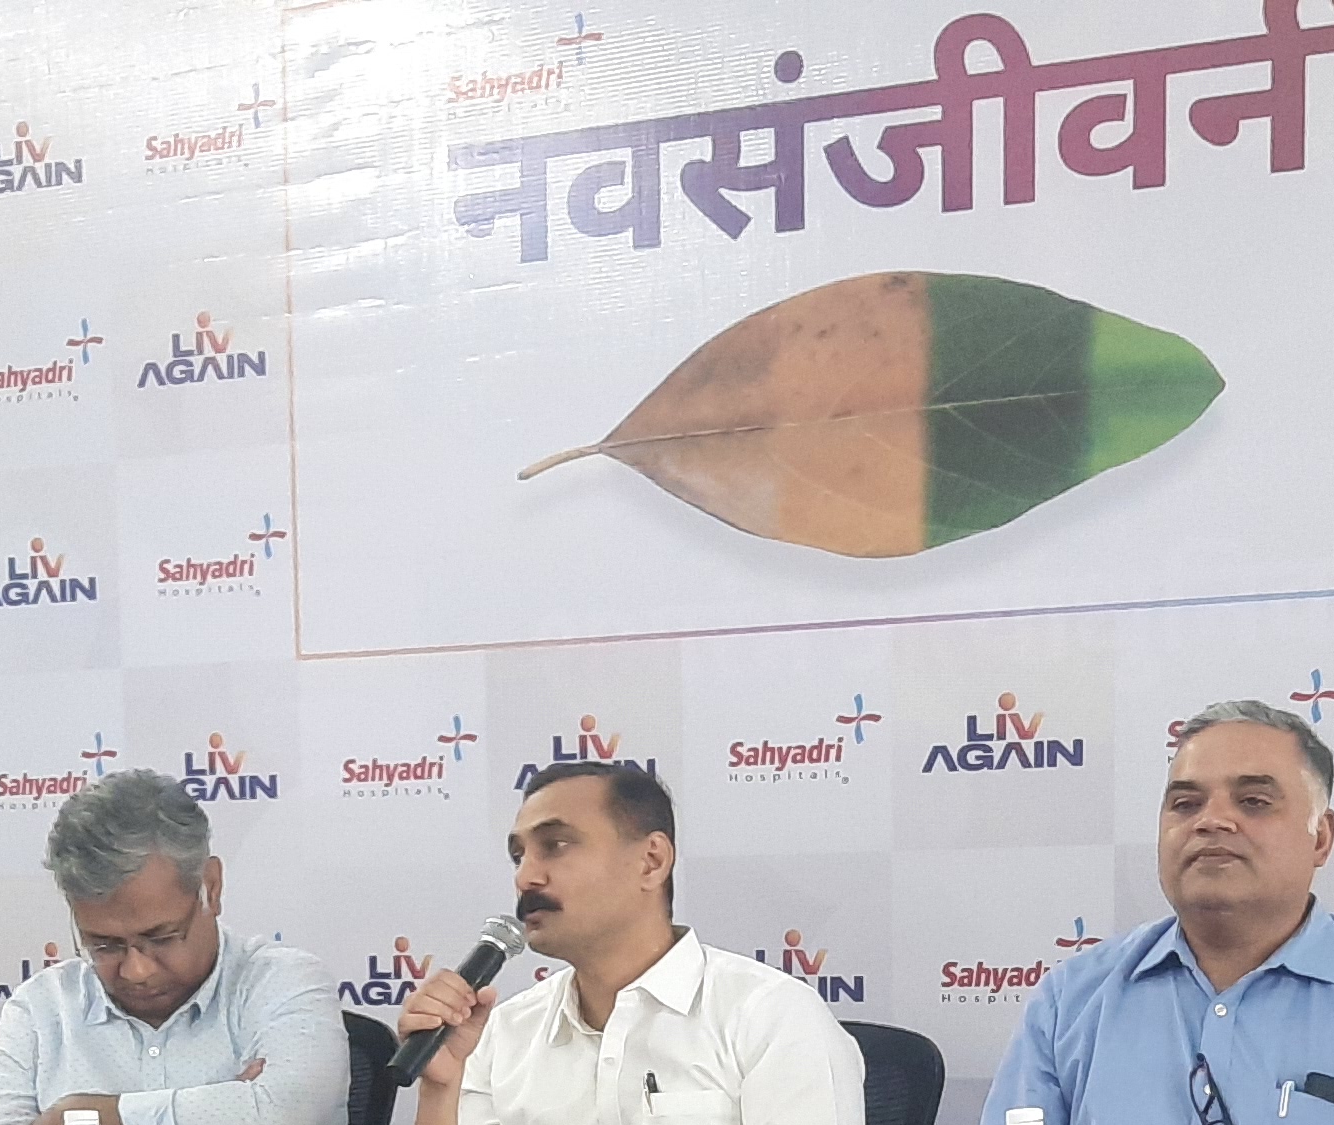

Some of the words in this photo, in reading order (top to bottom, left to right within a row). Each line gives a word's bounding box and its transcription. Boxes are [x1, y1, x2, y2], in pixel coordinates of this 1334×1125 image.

[446, 60, 564, 105] Sahyadri
[145, 124, 244, 162] Sahyadri
[171, 312, 233, 358] LIV
[137, 351, 266, 388] AGAIN
[6, 538, 63, 581] LIV
[158, 554, 256, 587] Sahyadri
[967, 692, 1045, 742] LIV
[184, 731, 247, 776] LIV
[553, 715, 621, 761] LIV
[728, 737, 844, 772] Sahyadri
[922, 739, 1083, 773] AGAIN
[180, 774, 278, 803] GAIN
[342, 755, 445, 790] Sahyadri
[368, 936, 434, 979] LIV
[338, 981, 417, 1006] AGA
[941, 960, 1052, 993] Sahyad
[941, 994, 1021, 1004] Hospit
